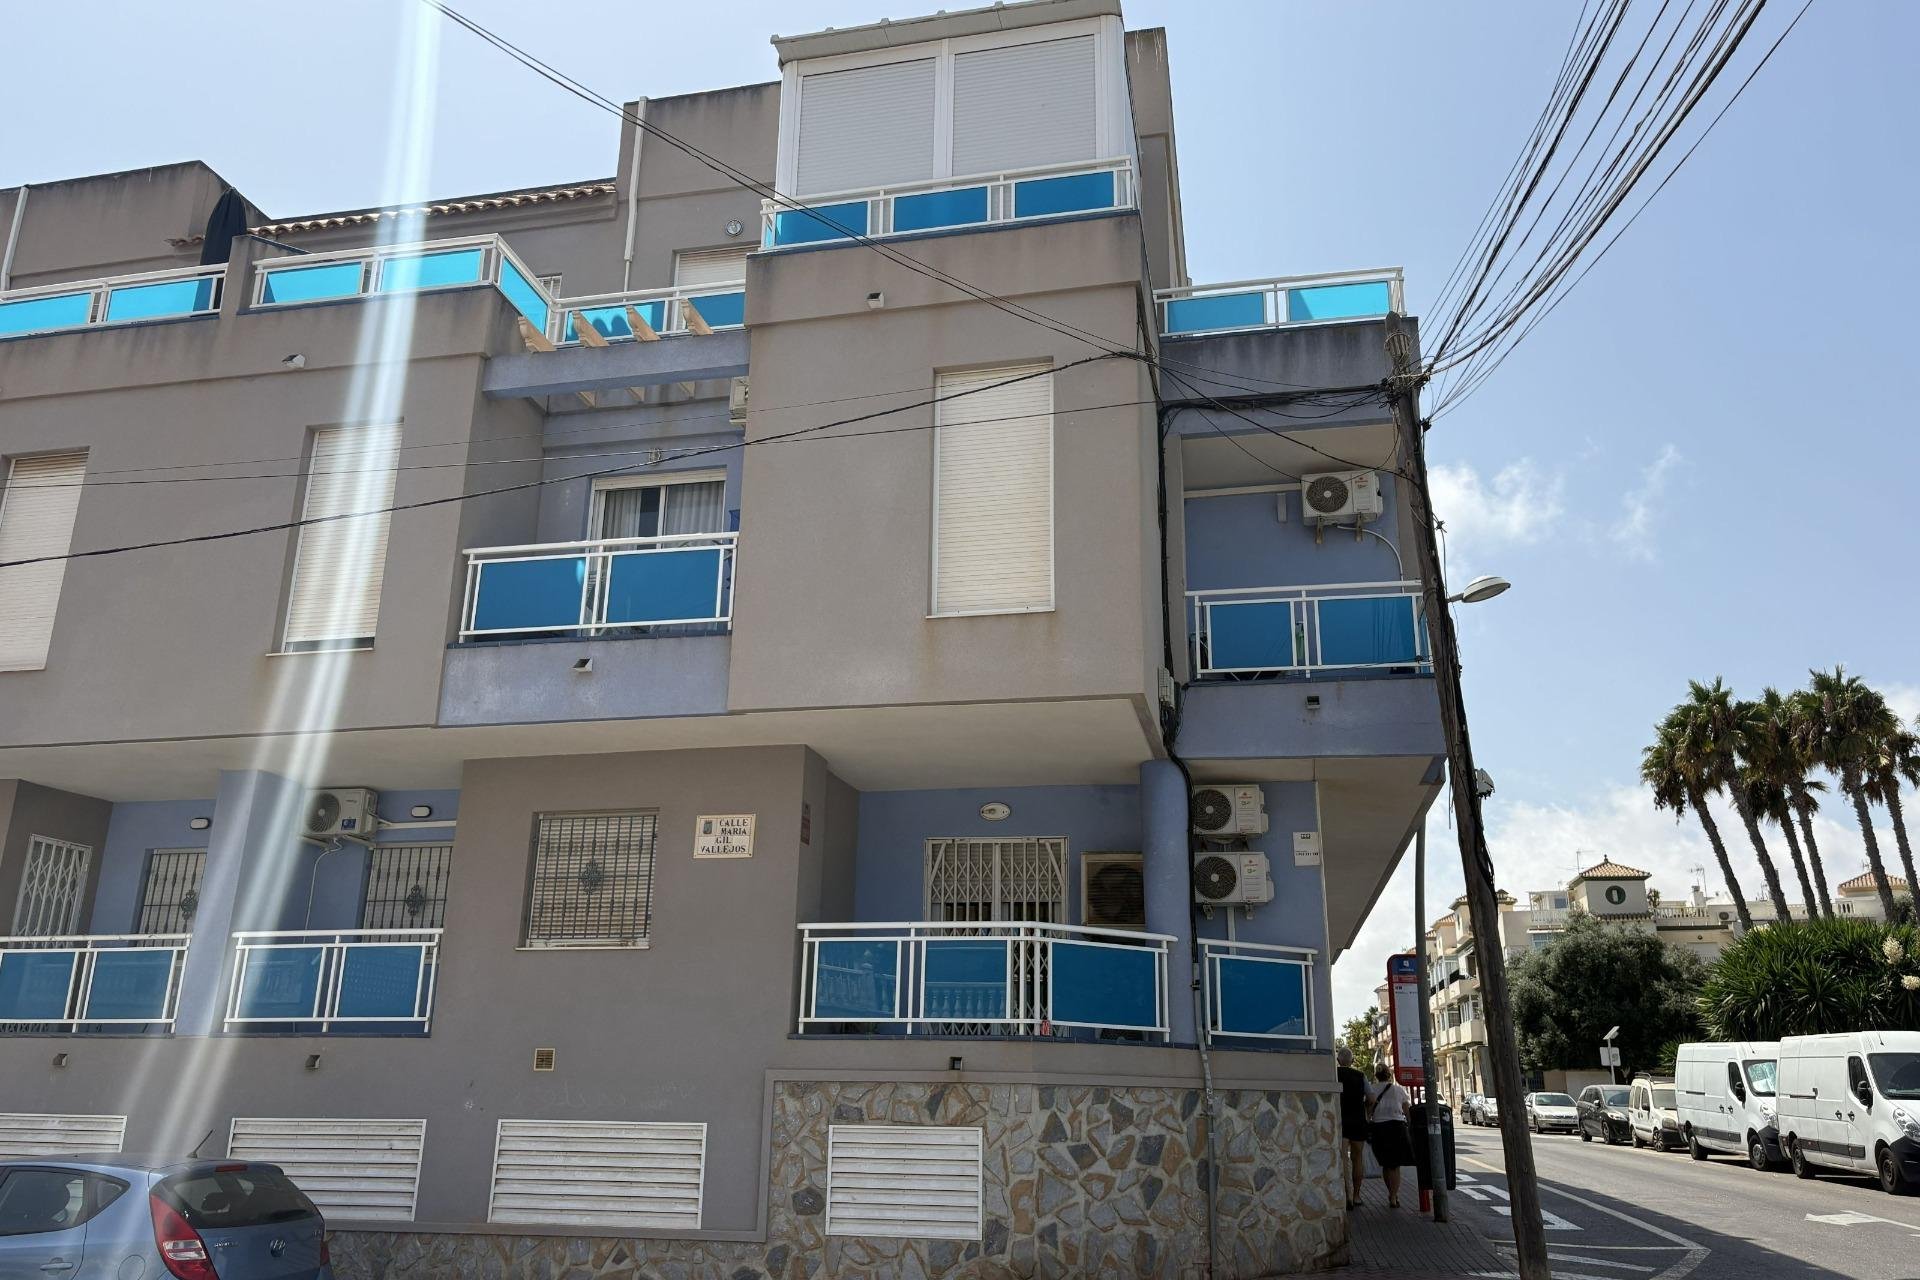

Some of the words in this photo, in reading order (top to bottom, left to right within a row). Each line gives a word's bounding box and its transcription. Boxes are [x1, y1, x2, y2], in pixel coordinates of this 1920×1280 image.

[719, 818, 748, 827] CALLE
[721, 827, 747, 835] MARIA
[716, 836, 732, 844] GIL
[701, 845, 746, 854] VALLEJOS
